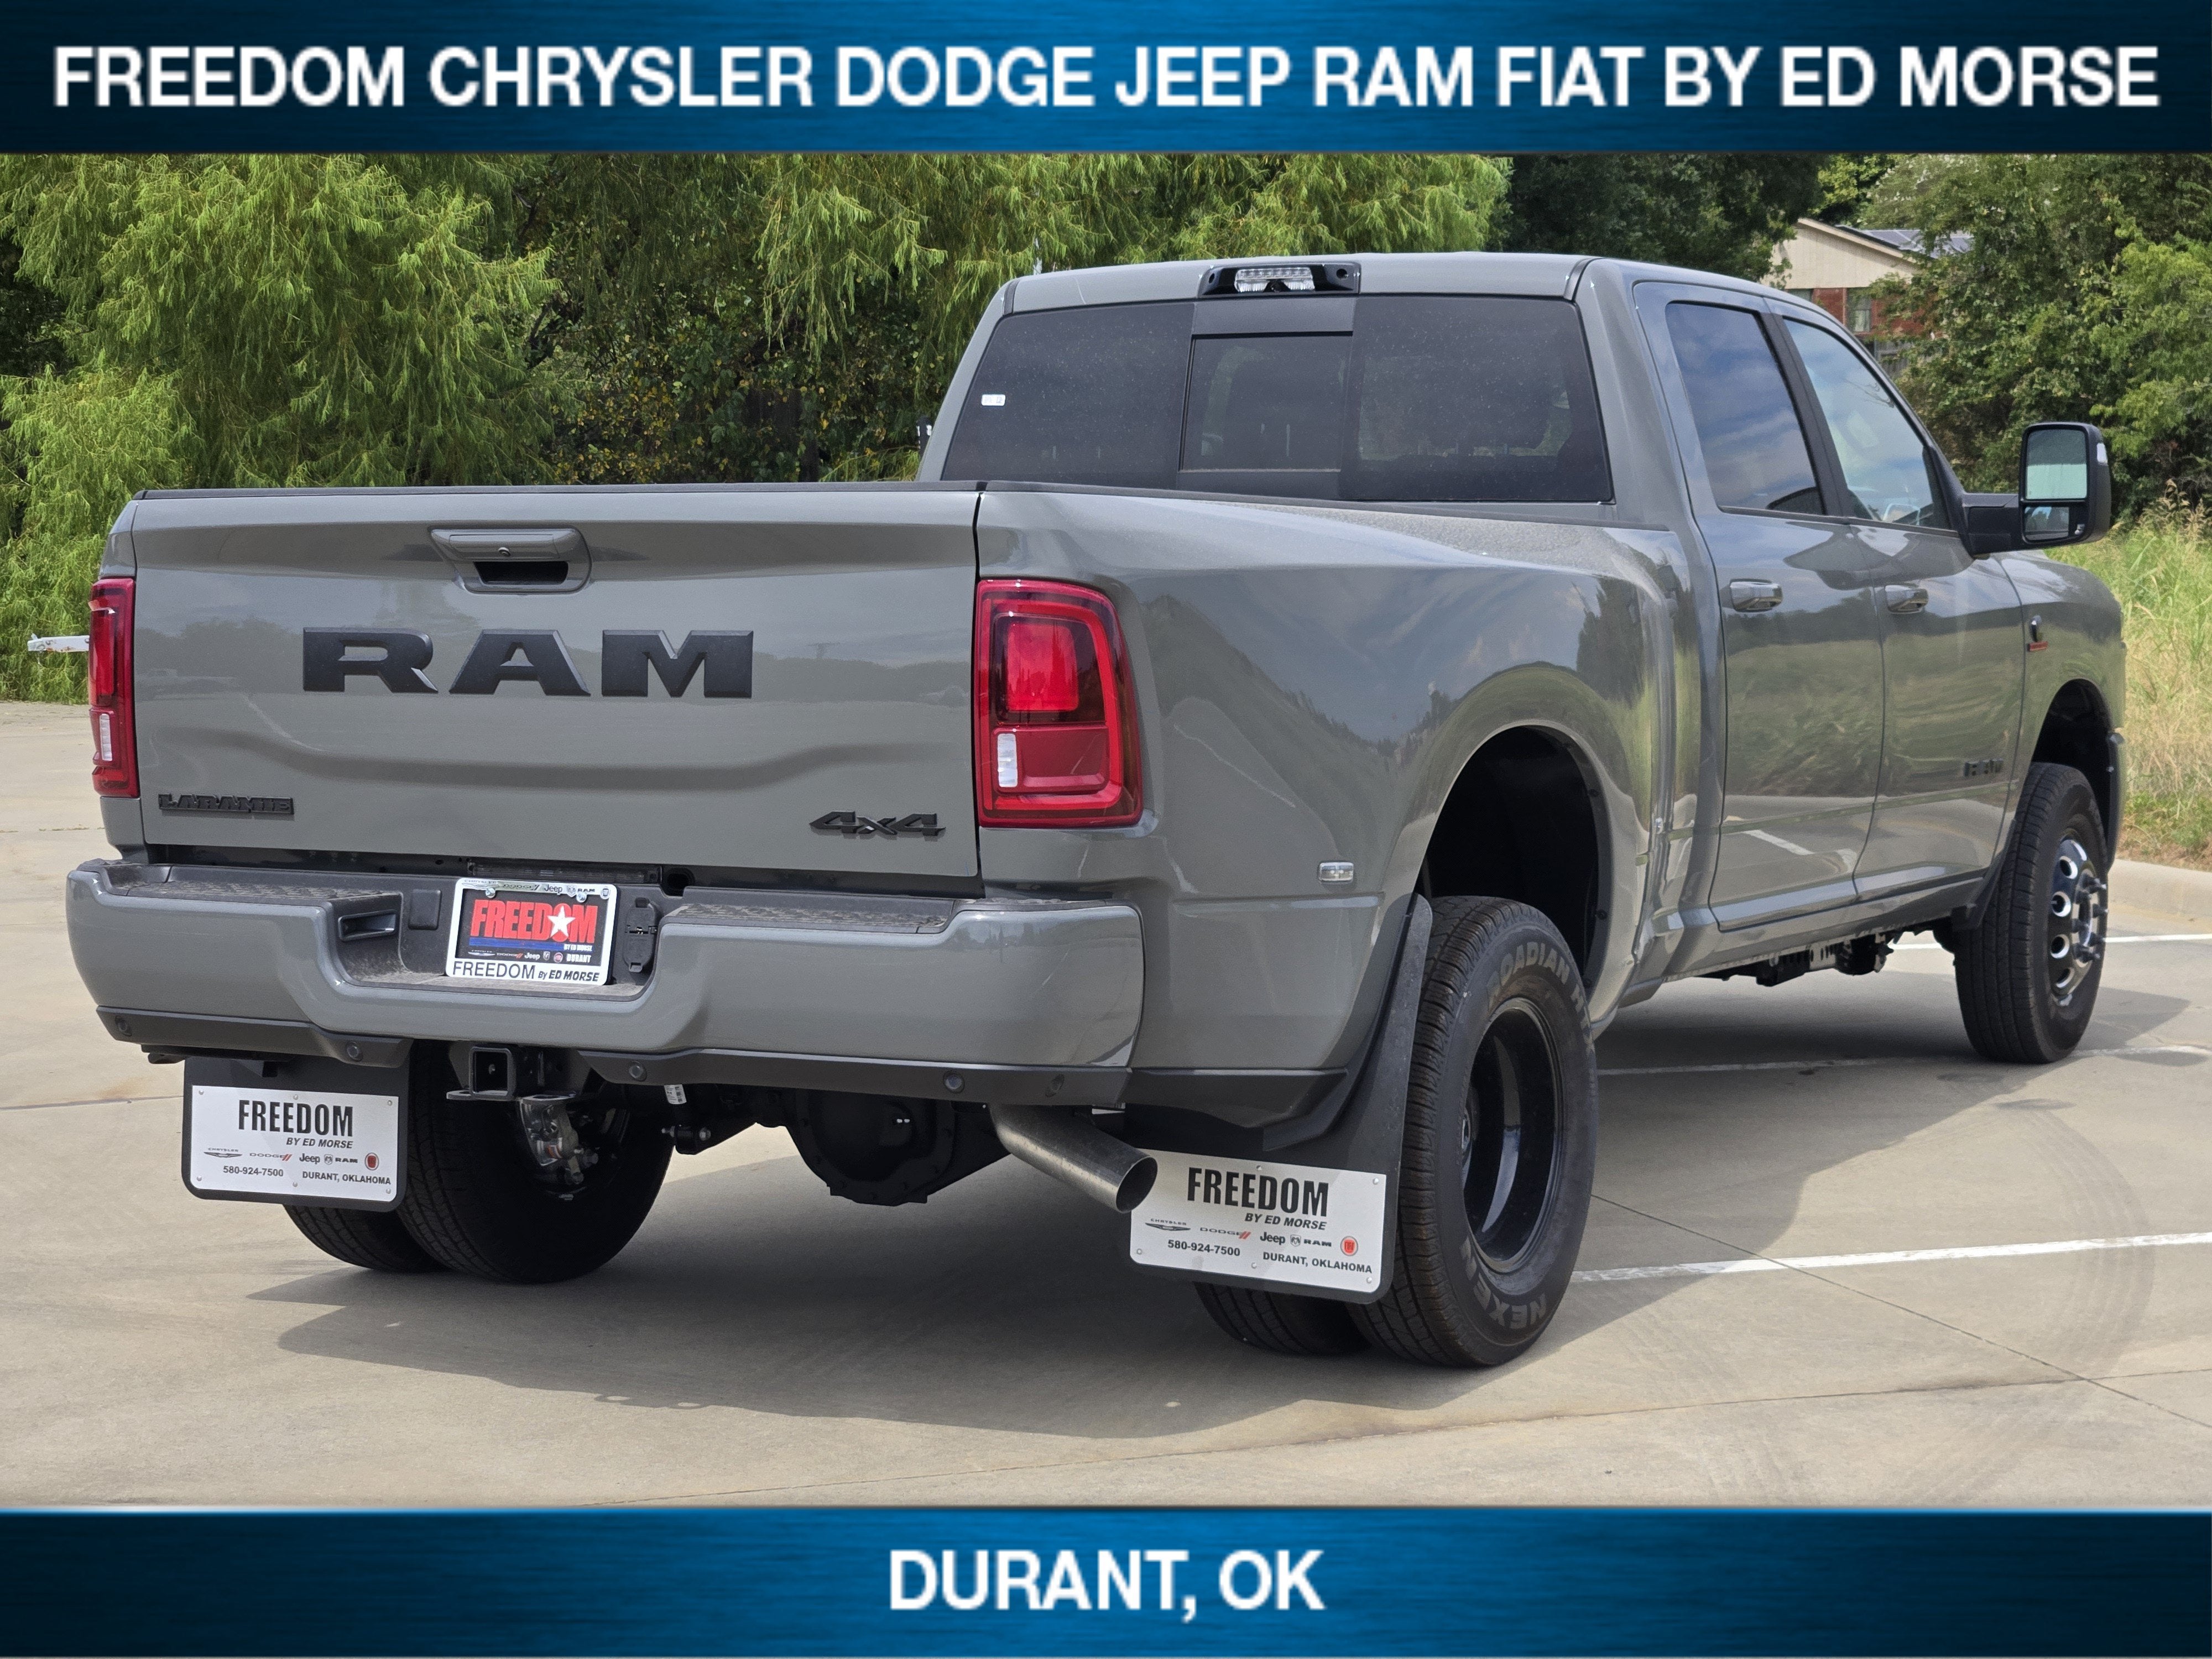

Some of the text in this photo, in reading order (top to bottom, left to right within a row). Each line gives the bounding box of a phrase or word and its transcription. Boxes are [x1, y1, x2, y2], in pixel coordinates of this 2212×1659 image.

[302, 627, 754, 698] RAM
[544, 884, 563, 893] Jeep
[470, 899, 598, 943] FREEDOM
[524, 952, 540, 961] Jeep
[567, 954, 592, 963] DURANT
[453, 961, 536, 979] FREEDOM
[549, 970, 562, 979] ED
[563, 971, 599, 982] MORSE
[238, 1099, 353, 1137] FREEDOM
[286, 1137, 353, 1149] BY ED MORSE
[299, 1153, 321, 1164] Jeep
[223, 1165, 284, 1177] 580-924-7500
[302, 1171, 391, 1185] DURANT, OKLAHOMA
[1187, 1167, 1329, 1217] FREEDOM
[1244, 1213, 1327, 1230] BY ED MORSE
[1260, 1232, 1286, 1245] Jeep
[1303, 1239, 1332, 1247] RAM
[1167, 1239, 1240, 1256] 580-924-7500
[1263, 1252, 1373, 1274] DURANT, OKLAHOMA
